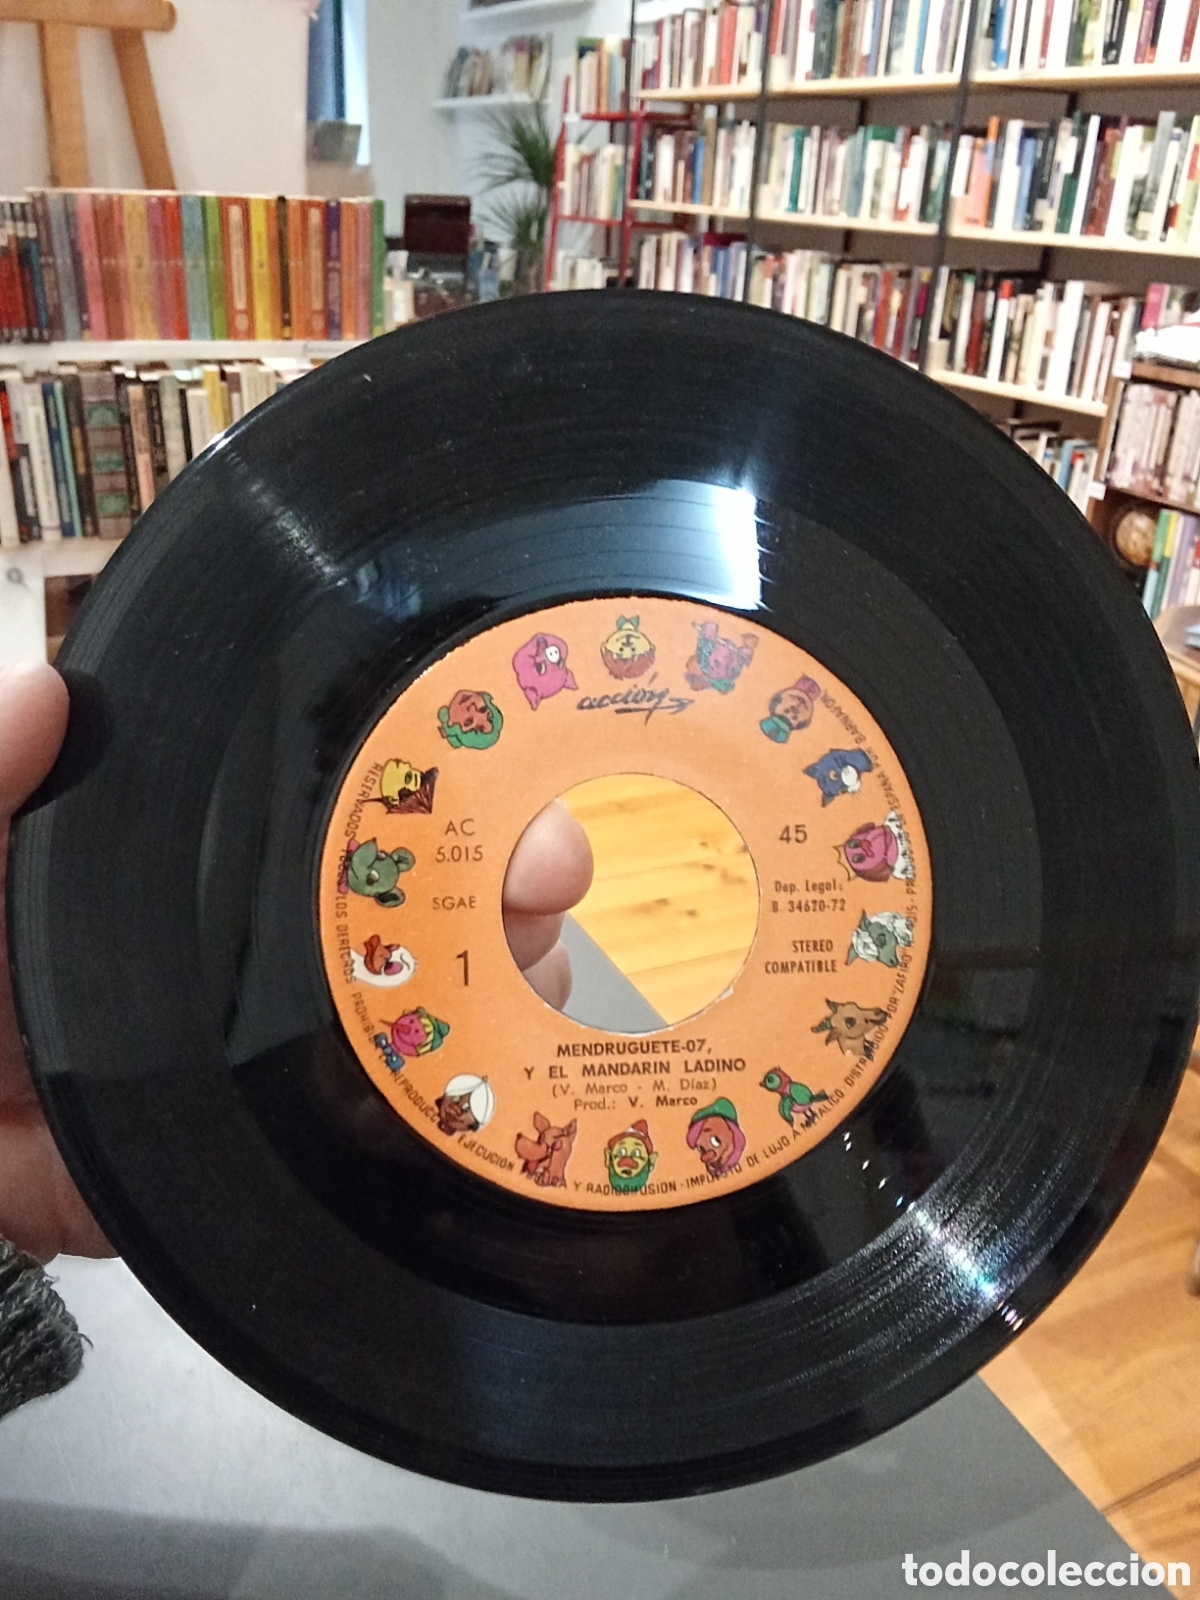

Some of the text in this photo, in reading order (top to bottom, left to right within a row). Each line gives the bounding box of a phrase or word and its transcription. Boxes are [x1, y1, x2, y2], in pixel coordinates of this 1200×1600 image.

[344, 761, 383, 839] RESERVADOS
[445, 818, 475, 836] AC
[779, 824, 808, 844] 45
[435, 845, 483, 863] 5.015
[336, 895, 346, 918] LOS
[432, 896, 476, 910] SGAE
[792, 939, 834, 953] STEREO
[456, 950, 469, 987] 1
[765, 959, 837, 974] COMPATIBLE
[557, 1038, 712, 1058] MENDRUGUETE-07,
[524, 1058, 746, 1081] Y EL MANDARIN LADINO
[552, 1084, 575, 1098] (V.
[585, 1083, 628, 1095] Marco
[652, 1080, 670, 1092] M.
[680, 1077, 717, 1092] Díaz)
[574, 1095, 698, 1111] Prod.: V. Marco
[788, 1127, 802, 1140] A
[457, 1131, 516, 1171] EJECUCION
[761, 1134, 791, 1158] LUJO
[744, 1152, 760, 1167] DE
